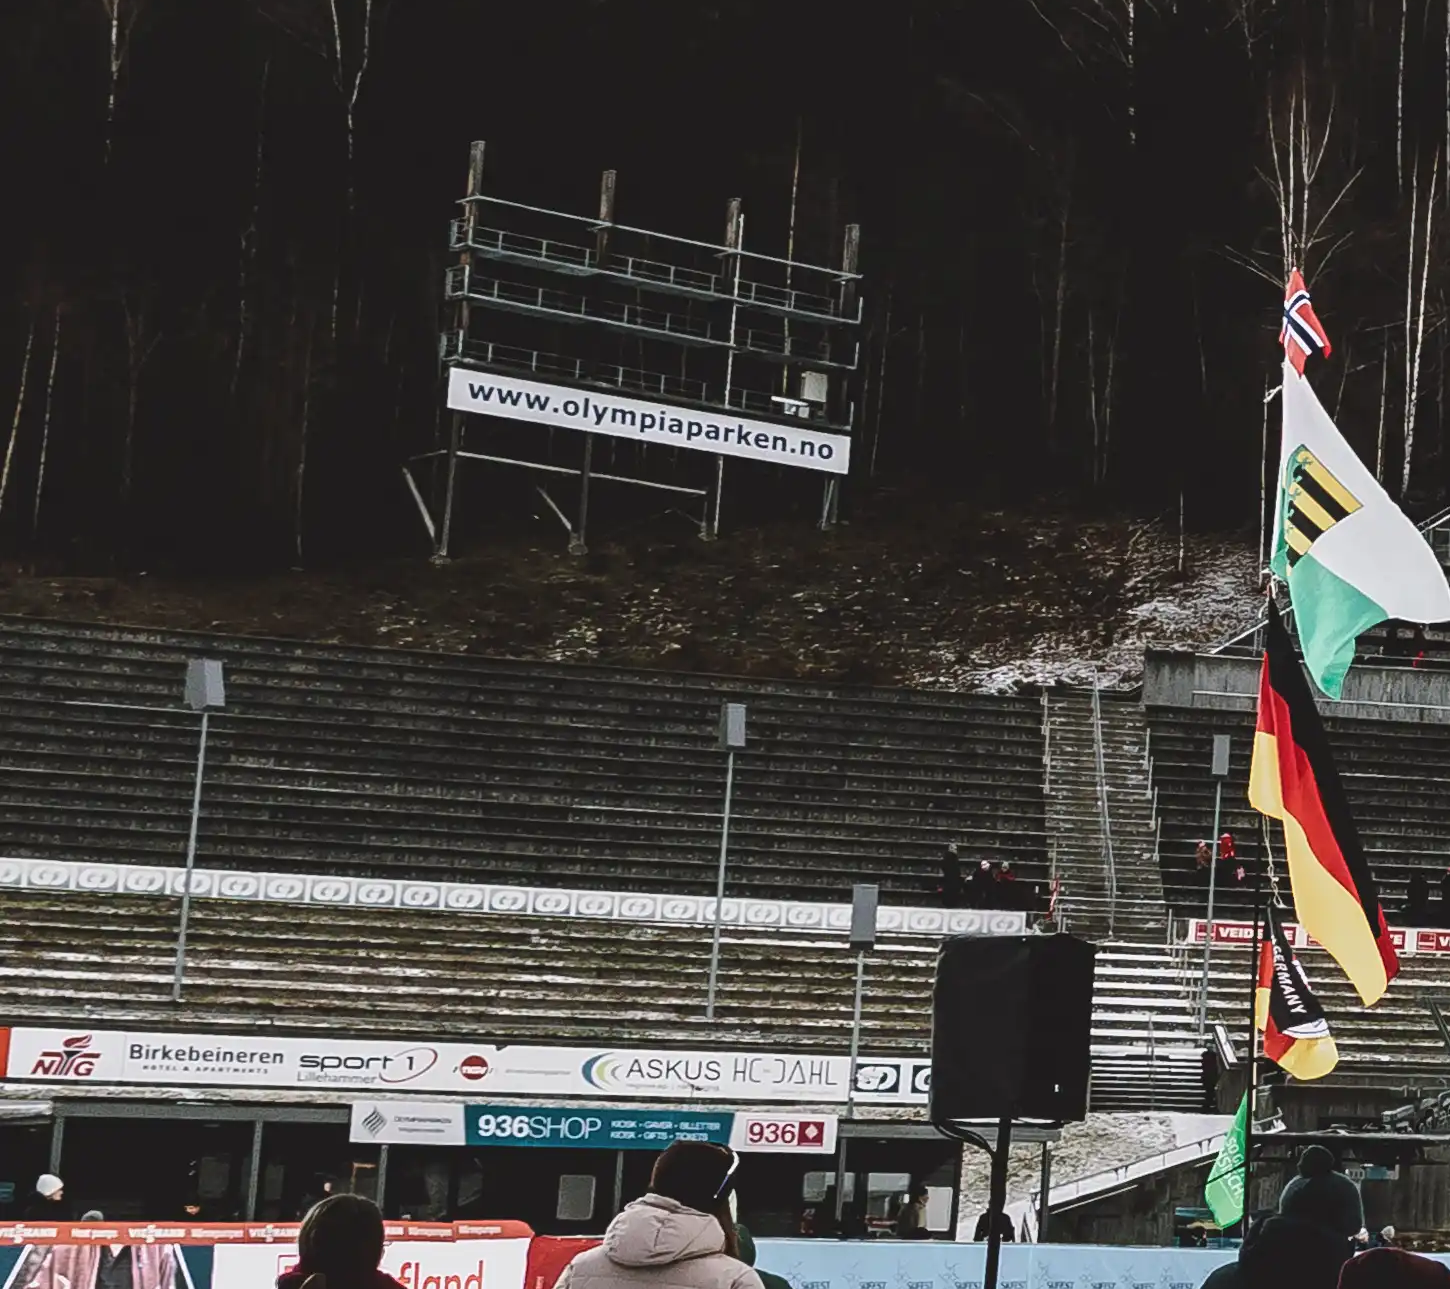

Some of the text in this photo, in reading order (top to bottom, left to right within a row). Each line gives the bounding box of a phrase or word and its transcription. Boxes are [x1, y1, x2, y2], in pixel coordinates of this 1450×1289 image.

[468, 381, 834, 460] www.olympiaparken.no
[1219, 926, 1293, 941] VEIDE
[1273, 946, 1308, 1013] GERMANY
[130, 1044, 284, 1064] Birkebeineren
[299, 1053, 395, 1072] sport
[297, 1071, 378, 1085] Lillehammer
[626, 1058, 721, 1081] ASKUS
[478, 1115, 601, 1140] 936SHOP
[748, 1123, 796, 1144] 936
